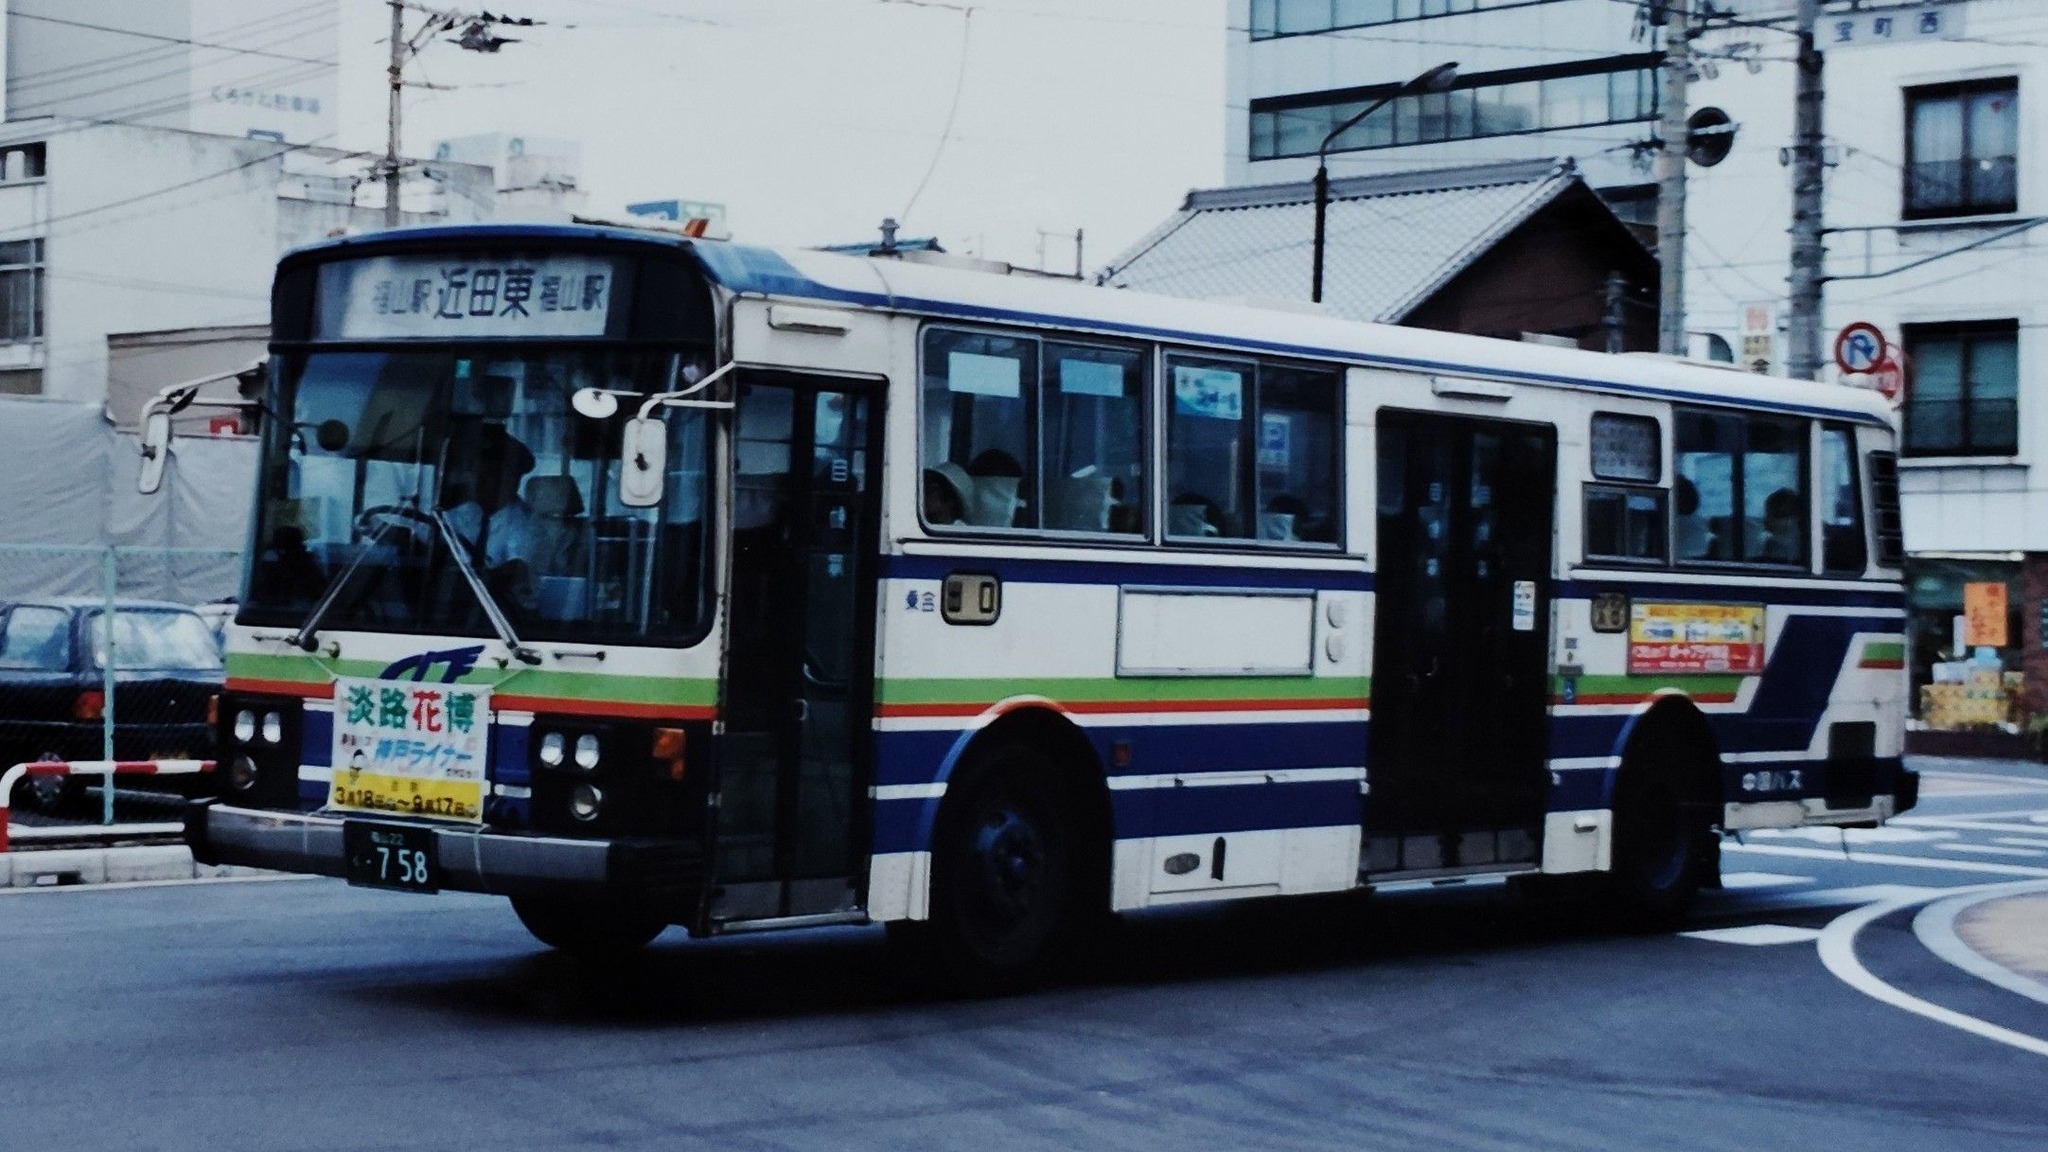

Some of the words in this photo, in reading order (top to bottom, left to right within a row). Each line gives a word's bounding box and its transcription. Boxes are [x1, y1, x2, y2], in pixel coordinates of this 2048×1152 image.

[433, 266, 537, 320] 近田東
[905, 590, 936, 613] 乗合
[346, 685, 476, 734] 淡路花博
[377, 846, 428, 884] 758
